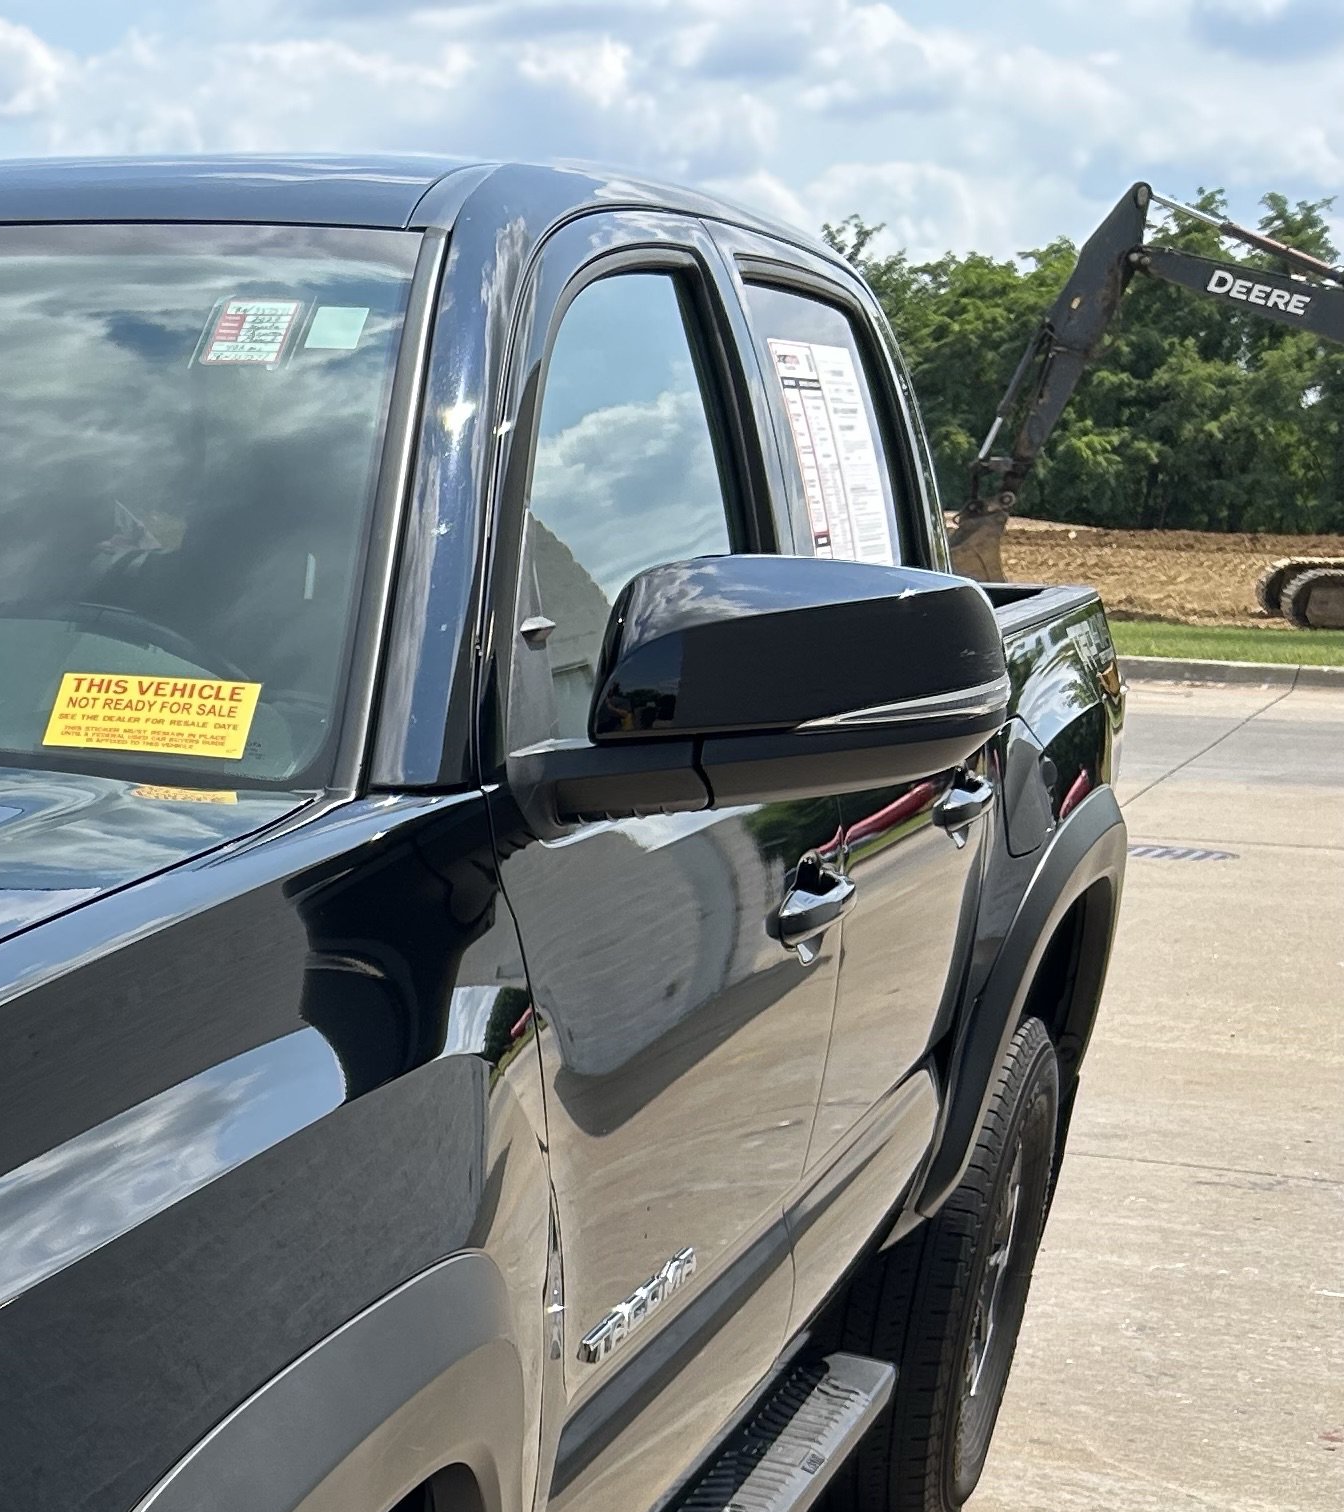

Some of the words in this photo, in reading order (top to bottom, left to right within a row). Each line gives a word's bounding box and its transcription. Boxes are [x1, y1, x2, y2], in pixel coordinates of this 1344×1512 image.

[1207, 270, 1312, 316] DEERE
[73, 678, 129, 695] THIS
[137, 681, 246, 702] VEHICLE
[66, 697, 100, 711] NOT
[102, 698, 157, 713] READY
[159, 701, 192, 715] FOR
[195, 705, 238, 718] SALE
[102, 715, 141, 723] DEALER
[145, 717, 166, 725] FOR
[169, 719, 209, 729] RESALE
[214, 723, 240, 731] DATE
[577, 1248, 696, 1363] TACOMA
